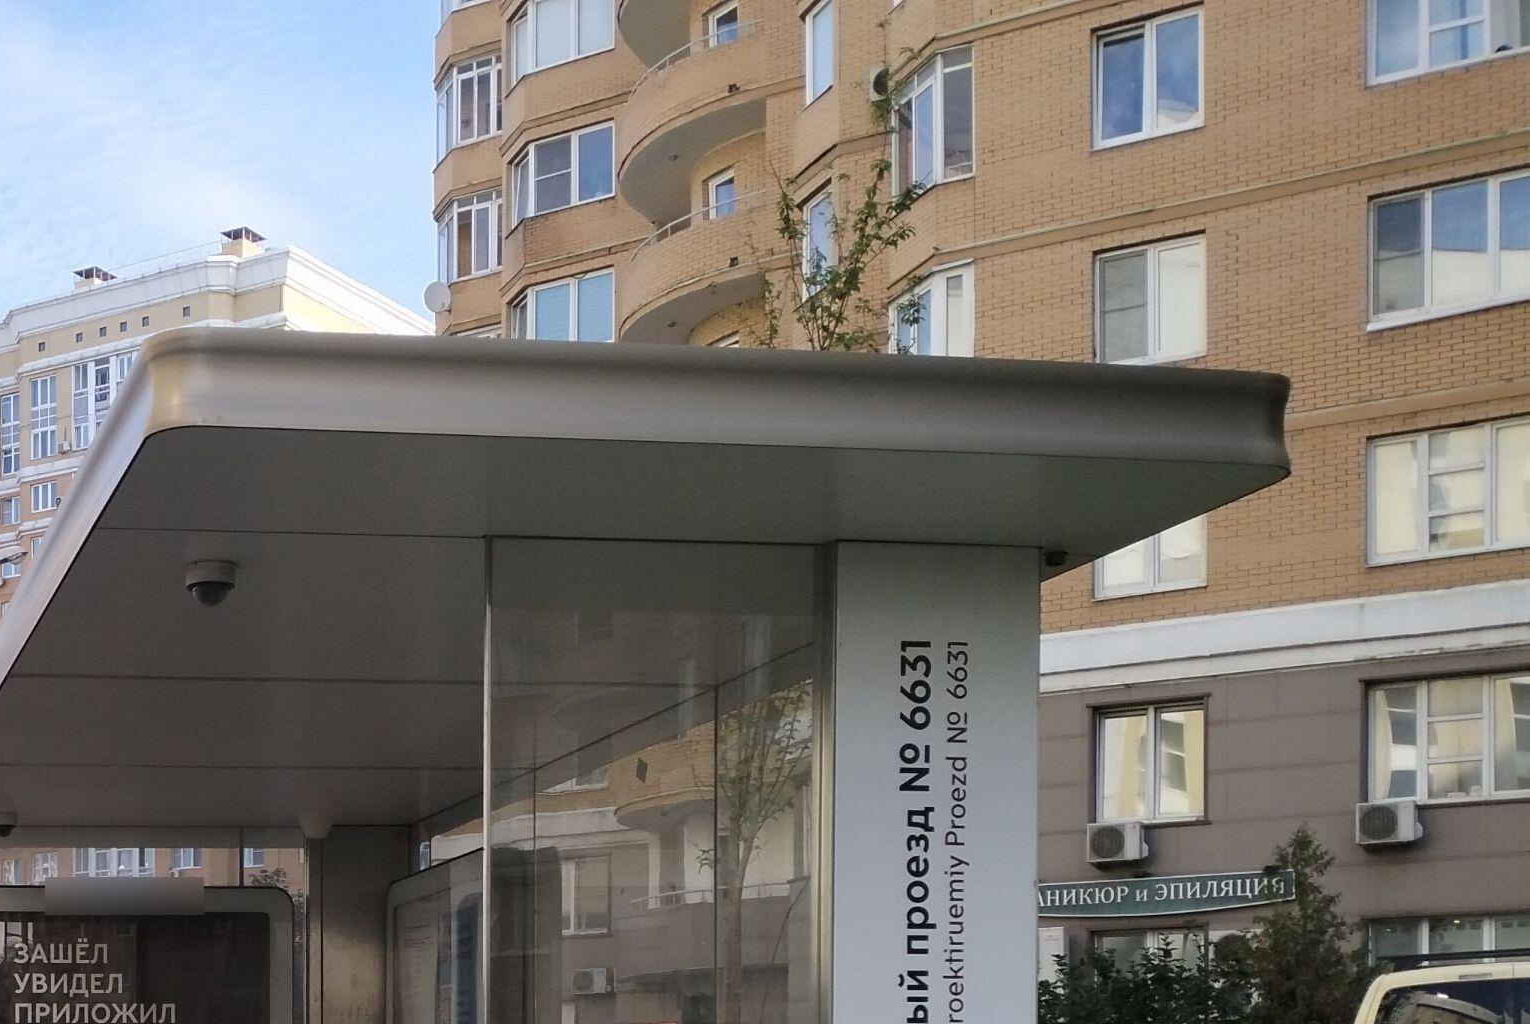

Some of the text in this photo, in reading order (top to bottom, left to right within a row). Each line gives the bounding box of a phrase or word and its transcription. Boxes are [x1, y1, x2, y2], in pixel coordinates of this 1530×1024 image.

[898, 640, 932, 731] 6631
[948, 639, 969, 700] 6631
[947, 711, 968, 744] №
[899, 742, 931, 792] №
[945, 756, 968, 846] Proezd
[907, 806, 936, 955] проезд
[1135, 889, 1148, 902] и
[1154, 877, 1285, 901] ЭПИЛЯЦИЯ
[14, 938, 108, 964] ЗАШЁЛ
[14, 973, 122, 998] УВИДЕЛ
[14, 1003, 176, 1024] ПРИЛОЖИЛ
